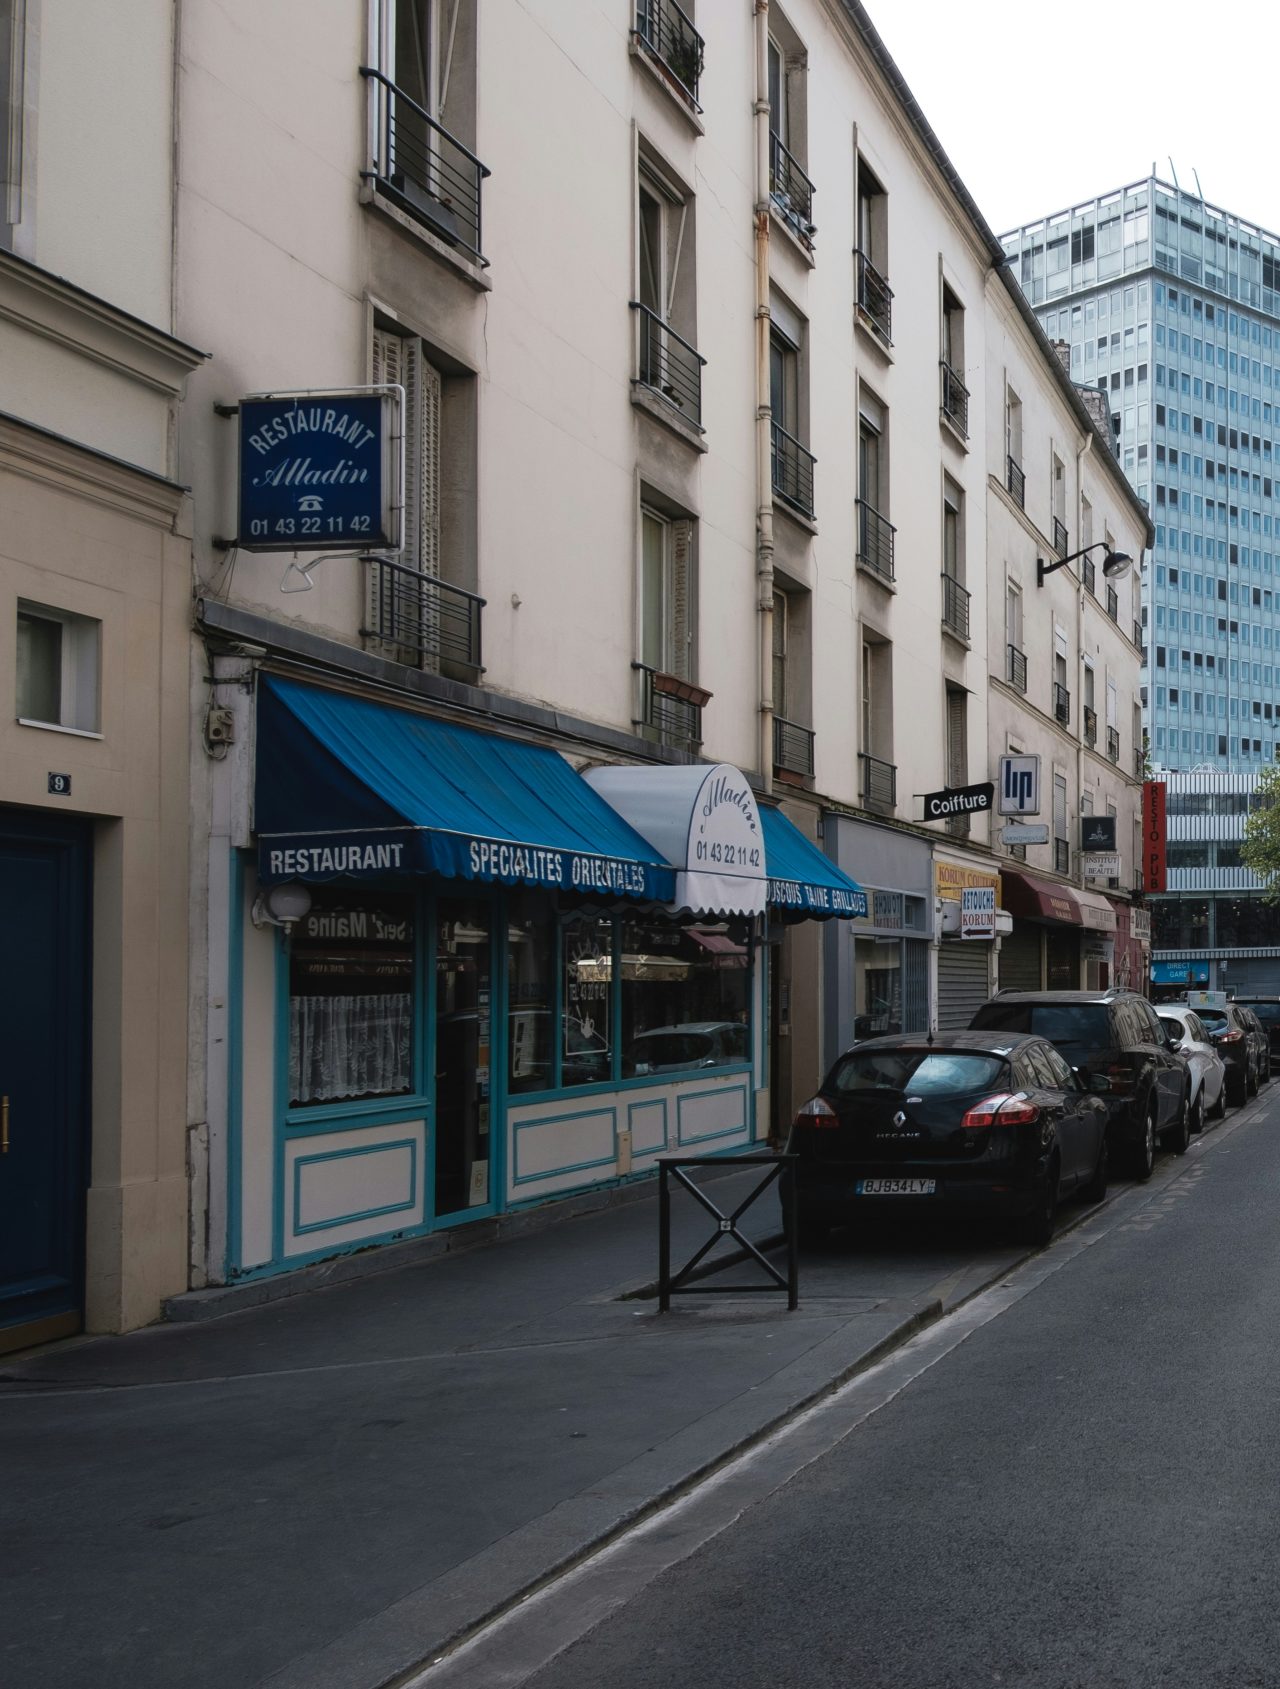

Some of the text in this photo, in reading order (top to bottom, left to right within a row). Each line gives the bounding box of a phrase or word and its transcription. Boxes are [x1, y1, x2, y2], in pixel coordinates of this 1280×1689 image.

[249, 407, 376, 455] RESTAURANT
[252, 457, 369, 488] Alladin
[251, 515, 370, 536] 01 43 22 11 42
[54, 775, 65, 791] 9
[700, 776, 759, 836] Alladin
[931, 794, 988, 815] Coiffure
[1150, 785, 1159, 842] RESTO
[270, 843, 404, 874] RESTAURANT
[696, 840, 760, 867] 01 43 22 11 42
[1086, 856, 1117, 864] INSTITUT
[469, 841, 645, 893] SPECIALITES ORIENTALES
[938, 866, 965, 886] KORUM
[1088, 867, 1115, 875] BEAUTE
[1150, 853, 1159, 889] PUB
[766, 879, 866, 913] OUSCOUS TAJINE GRILLADES
[963, 890, 994, 910] RETOUCHE
[963, 913, 994, 926] KORUM
[1169, 970, 1187, 978] GARE
